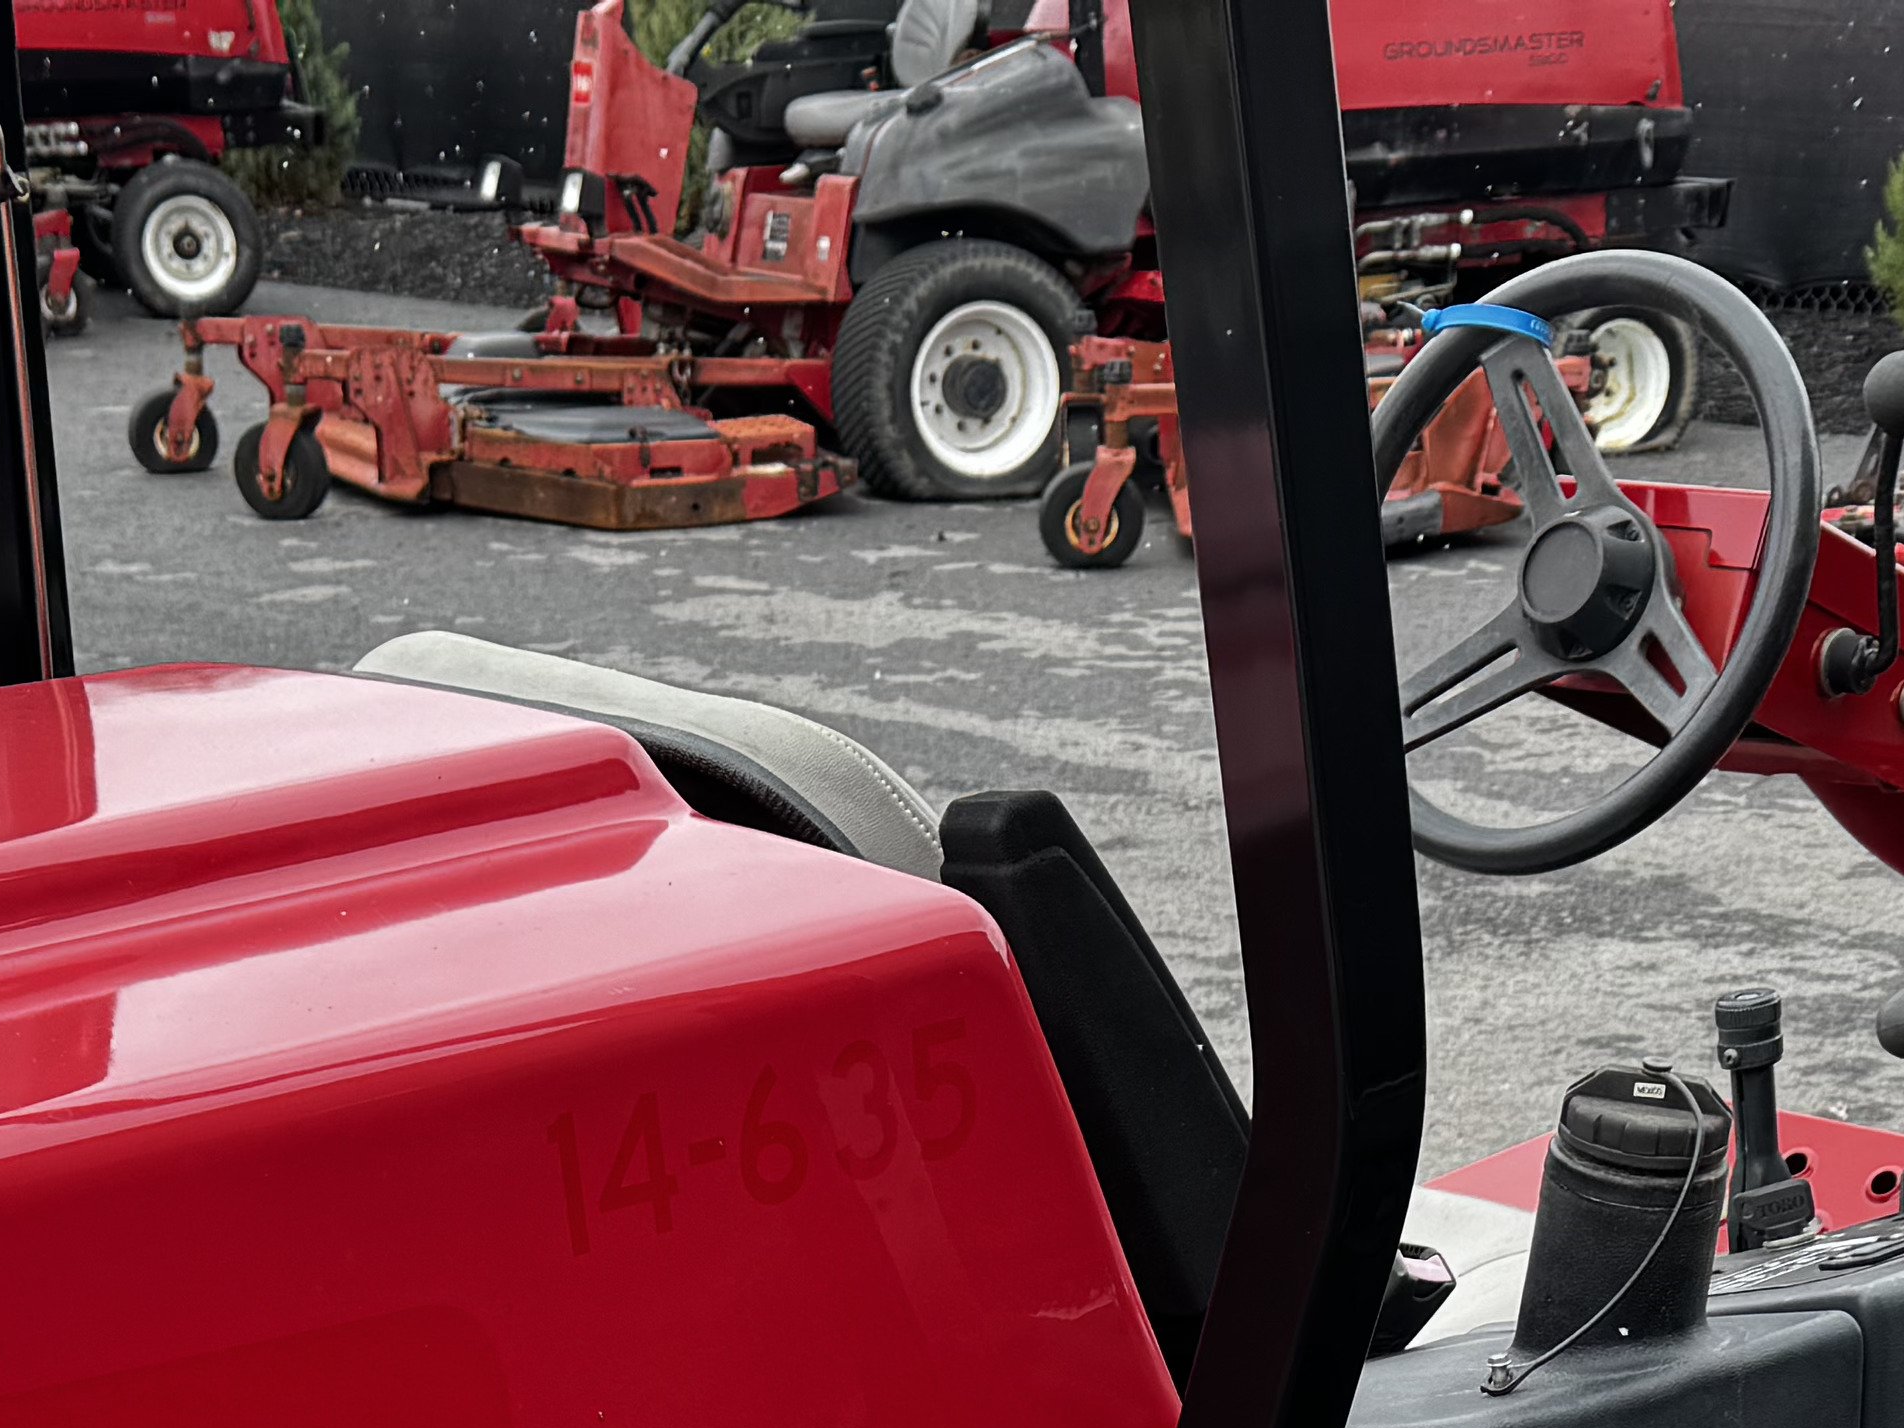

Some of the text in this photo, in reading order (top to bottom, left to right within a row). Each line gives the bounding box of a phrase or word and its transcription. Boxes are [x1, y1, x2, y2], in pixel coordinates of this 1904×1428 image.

[1384, 31, 1586, 60] GROUNDSMASTER
[545, 1017, 978, 1259] 14-635
[1759, 1194, 1804, 1218] TORO
